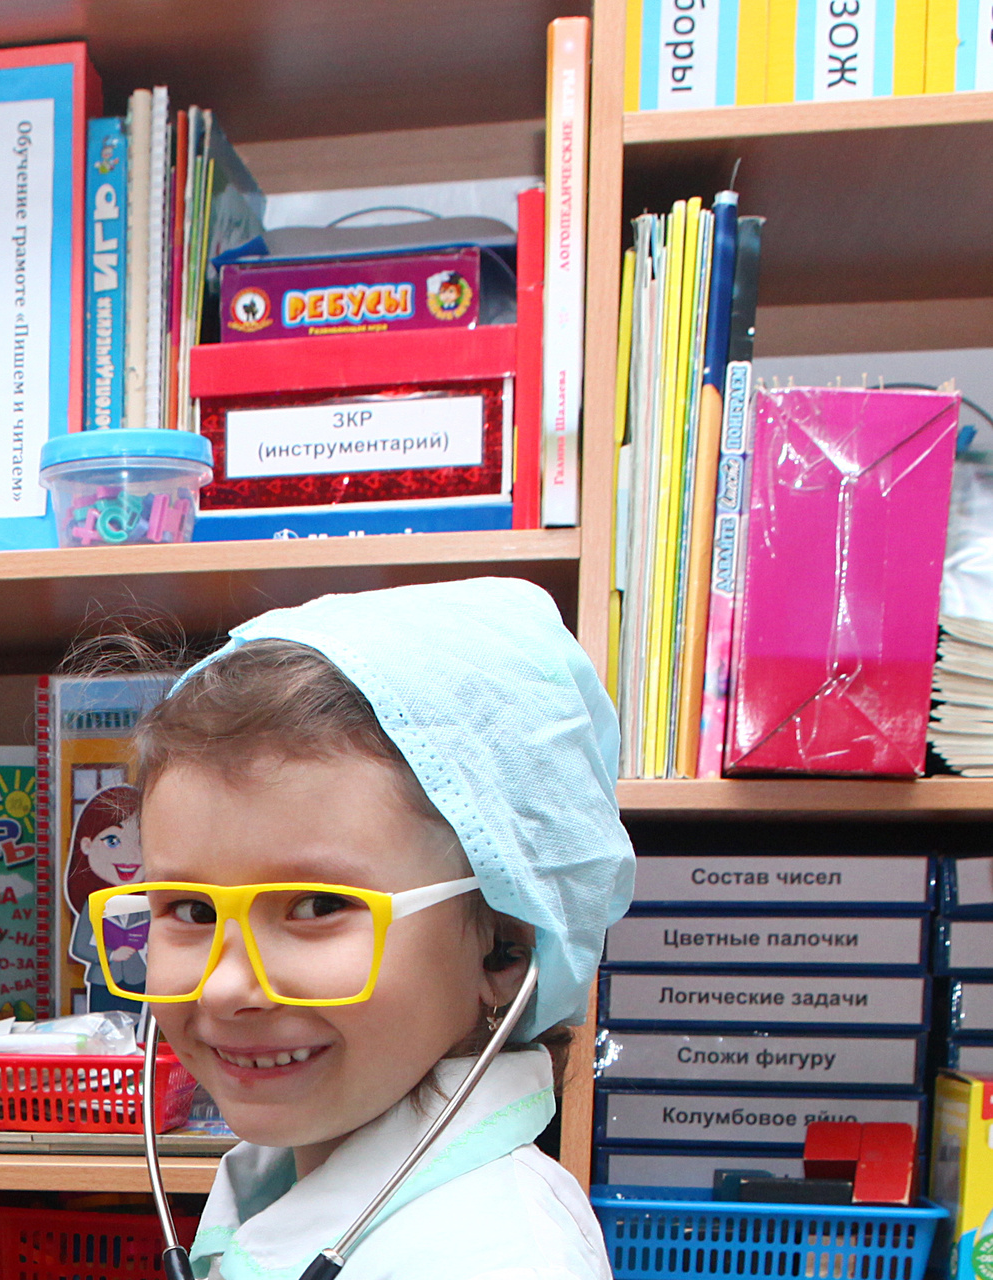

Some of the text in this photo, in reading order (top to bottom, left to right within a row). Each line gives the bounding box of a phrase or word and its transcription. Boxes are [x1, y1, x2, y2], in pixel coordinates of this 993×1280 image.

[828, 0, 860, 88] ЗОЖ
[13, 120, 33, 220] Обучение
[92, 184, 119, 293] ИГР
[11, 225, 27, 308] грамоте
[286, 286, 412, 323] РЕБУСЫ
[13, 312, 29, 395] «Пишем
[333, 410, 373, 429] ЗКР
[724, 365, 747, 450] ПОИГРАЕМ
[11, 418, 26, 503] читаем»
[257, 431, 450, 463] (инструментарий)
[553, 436, 567, 486] Галина
[715, 517, 736, 593] ДАВАЙТЕ
[691, 867, 842, 887] Состав чисел
[663, 929, 859, 949] Цветные палочки
[658, 986, 869, 1008] Логические задачи
[676, 1046, 837, 1071] Сложи фигуру
[662, 1106, 798, 1128] Колумбовое
